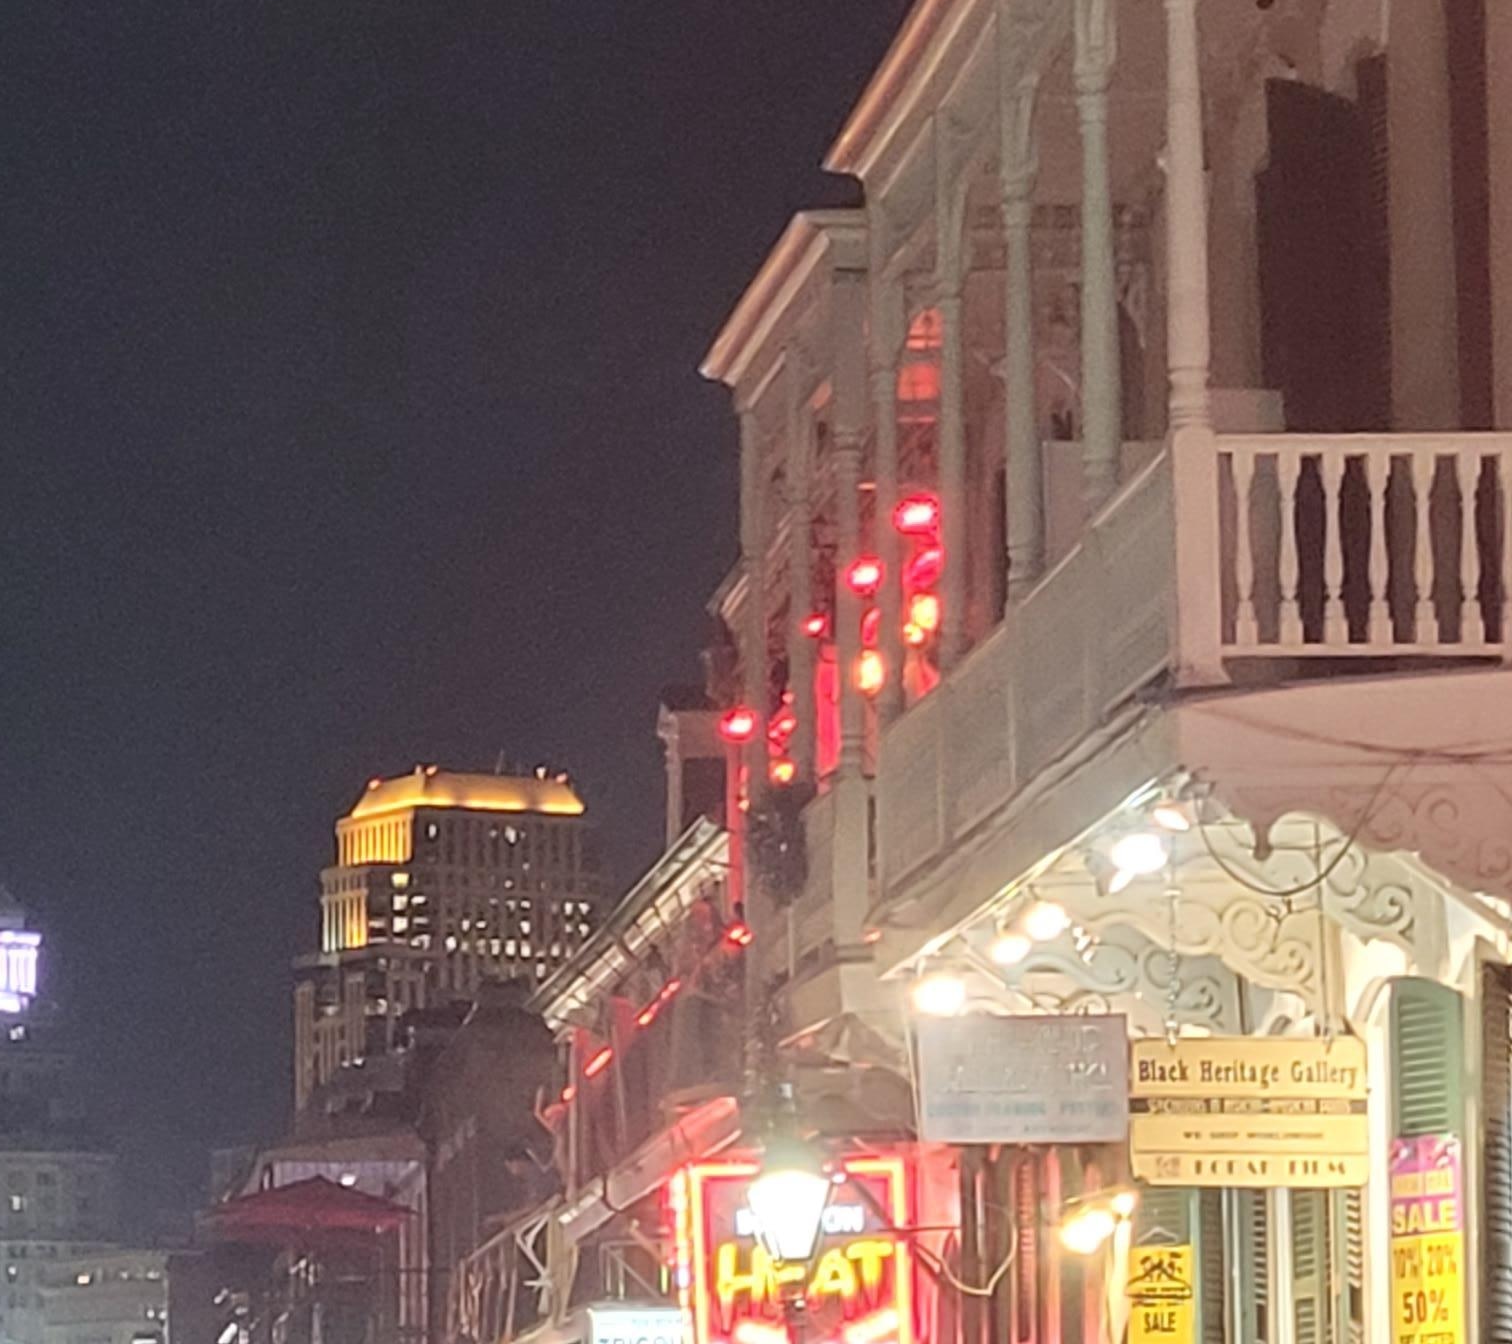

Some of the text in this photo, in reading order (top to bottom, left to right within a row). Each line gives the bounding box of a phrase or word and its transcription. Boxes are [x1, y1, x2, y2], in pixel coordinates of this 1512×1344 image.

[1138, 1059, 1188, 1082] Black
[1200, 1059, 1279, 1089] Heritage
[1291, 1060, 1358, 1089] Gallery
[1392, 1201, 1457, 1234] SALE
[1143, 1311, 1176, 1333] SALE
[1402, 1289, 1449, 1324] 50%
